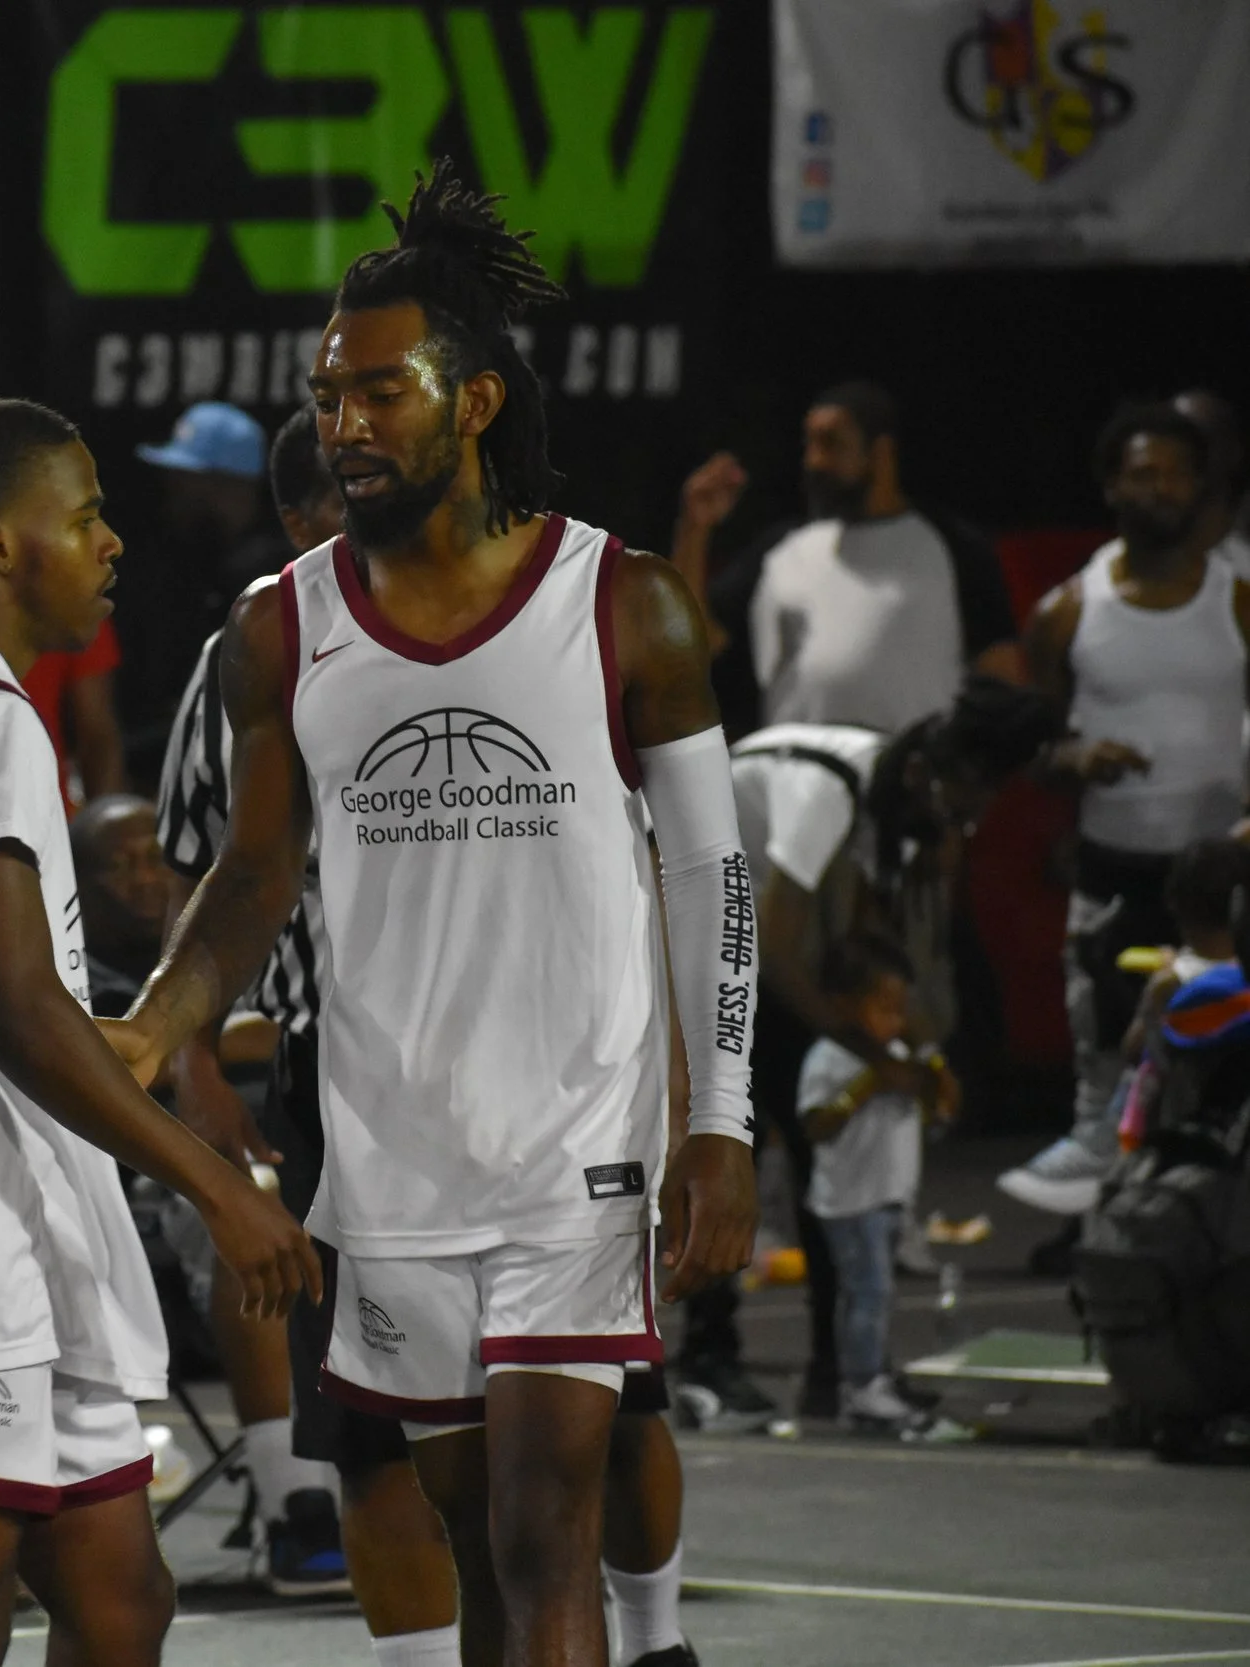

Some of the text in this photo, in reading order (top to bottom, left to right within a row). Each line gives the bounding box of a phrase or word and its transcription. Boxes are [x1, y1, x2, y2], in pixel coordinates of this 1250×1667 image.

[340, 775, 576, 818] George Goodman
[356, 815, 559, 845] Roundball Classic
[721, 851, 754, 968] CHECKERS
[717, 981, 749, 1056] CHESS.
